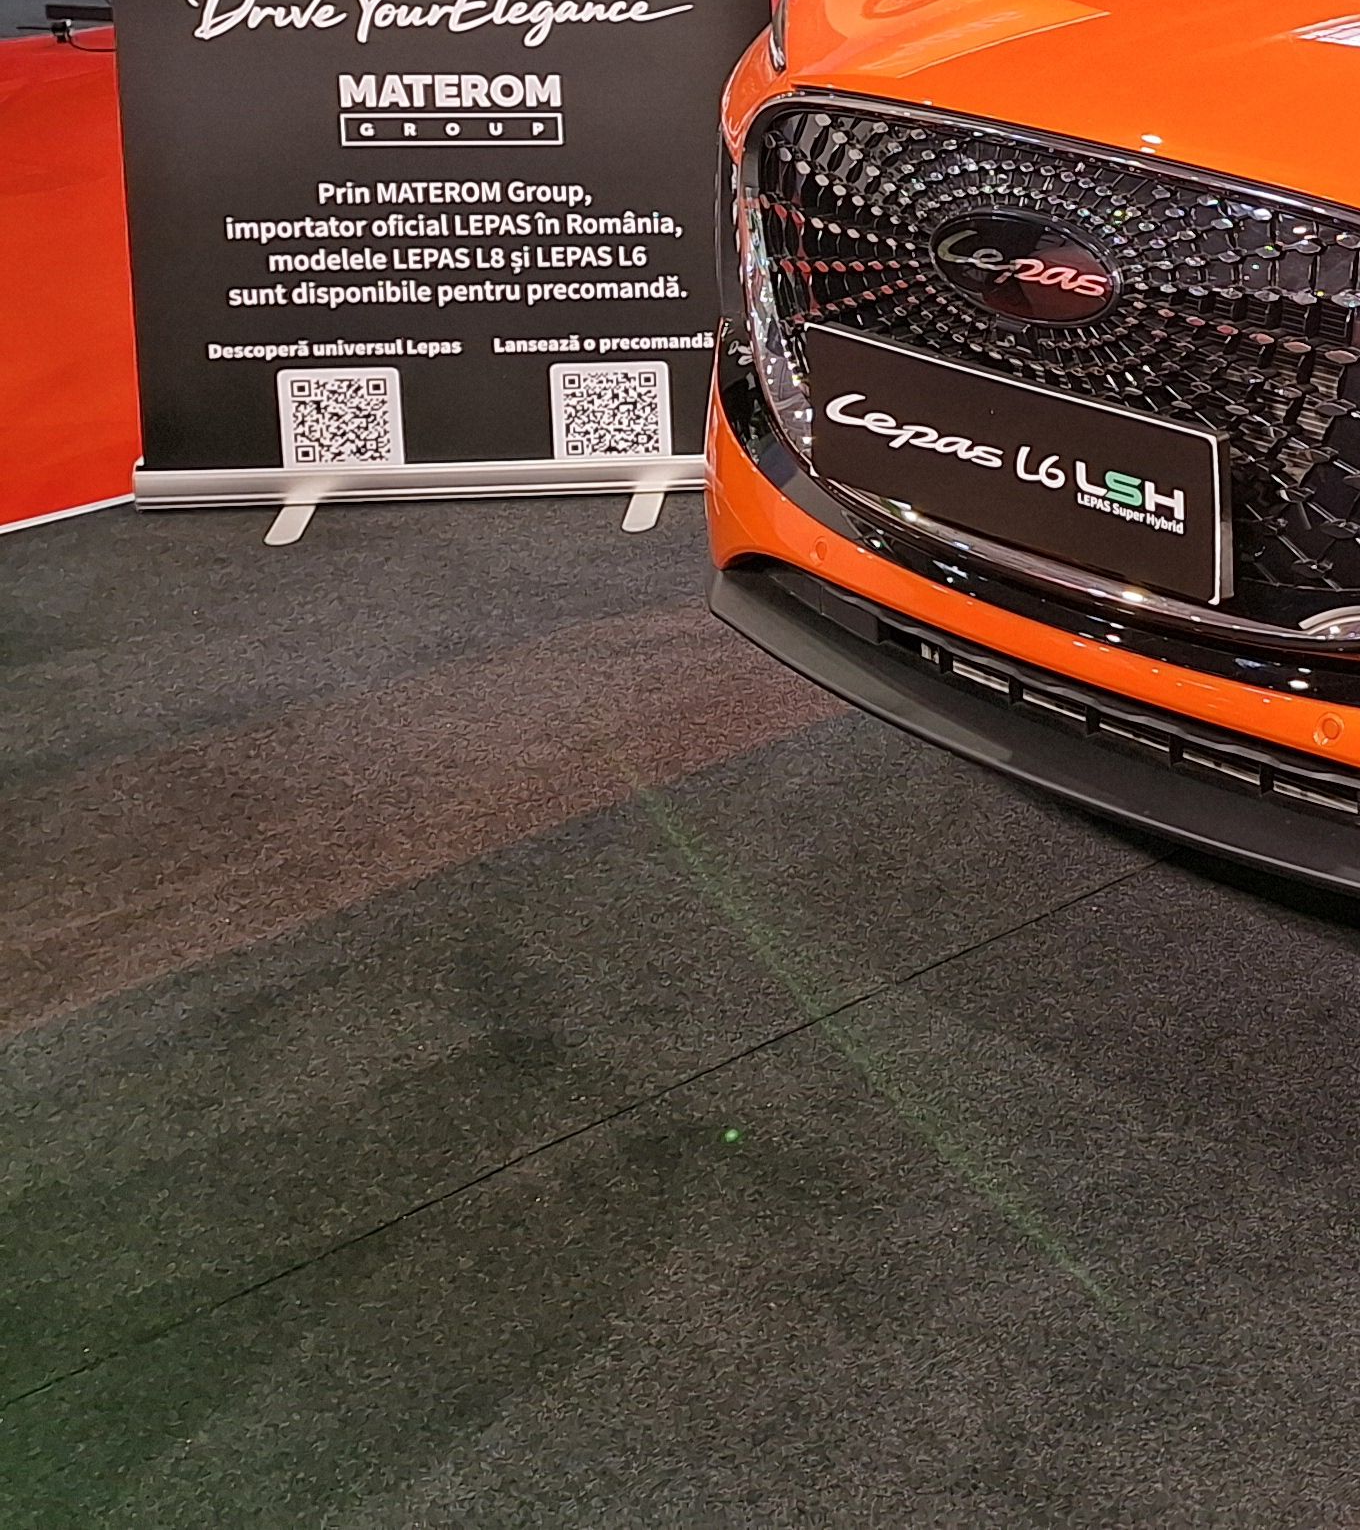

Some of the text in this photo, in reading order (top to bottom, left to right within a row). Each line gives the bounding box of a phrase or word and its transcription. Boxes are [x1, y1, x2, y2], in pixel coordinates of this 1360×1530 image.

[339, 74, 562, 108] MATEROM
[359, 122, 545, 138] GROUP
[318, 181, 593, 207] Prin MATEROM Group,
[225, 211, 684, 244] importator oficial LEPAS în România,
[268, 245, 648, 274] modelele LEPAS L8 și LEPAS L6
[937, 229, 1108, 297] Lepas
[228, 275, 688, 309] sunt disponibile pentru precomandă.
[208, 338, 463, 361] Descoperă universul Lepas
[493, 332, 714, 354] Lansează o precomandă
[825, 393, 1185, 521] Lepas L6 LSH
[1077, 492, 1184, 535] LEPAS Super Hybrid
